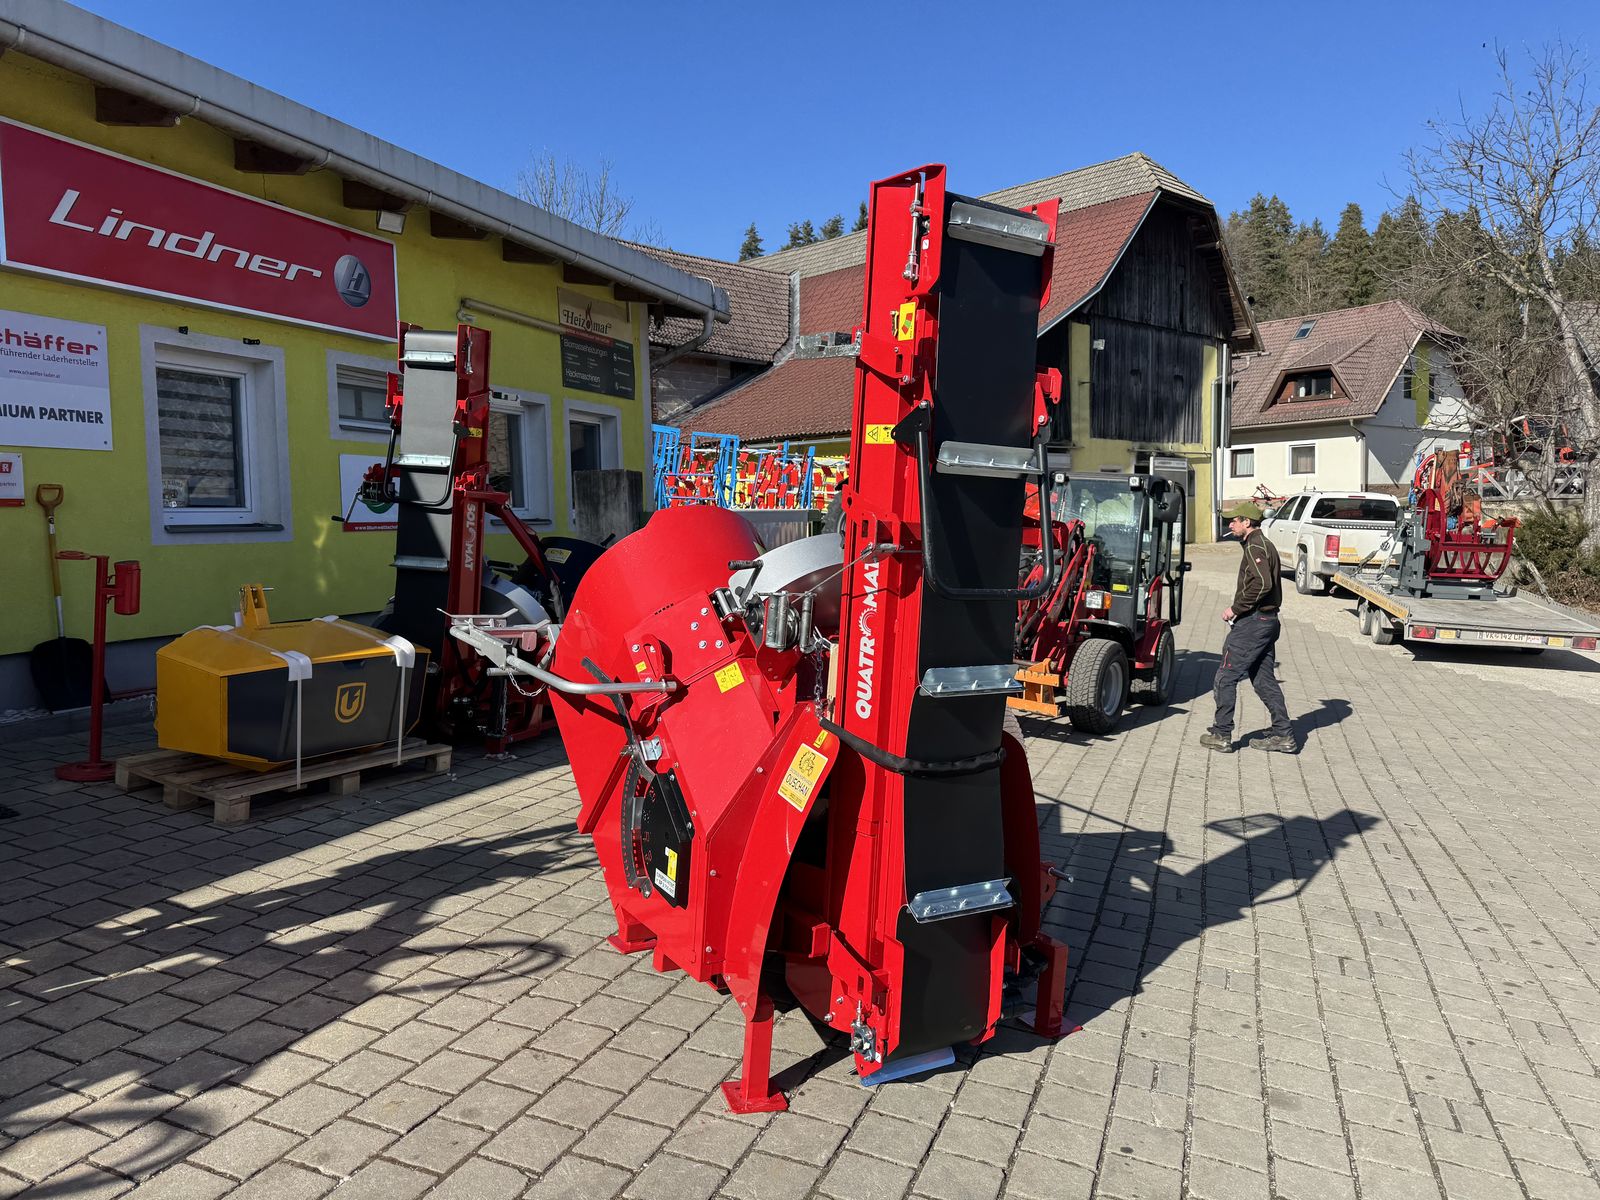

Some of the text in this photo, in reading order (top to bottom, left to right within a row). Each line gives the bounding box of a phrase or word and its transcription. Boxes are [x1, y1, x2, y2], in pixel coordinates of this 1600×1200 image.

[49, 189, 322, 281] Lindner
[0, 328, 99, 355] häffer
[42, 354, 98, 367] Laderhersteller
[0, 404, 104, 424] IUM PARTNER
